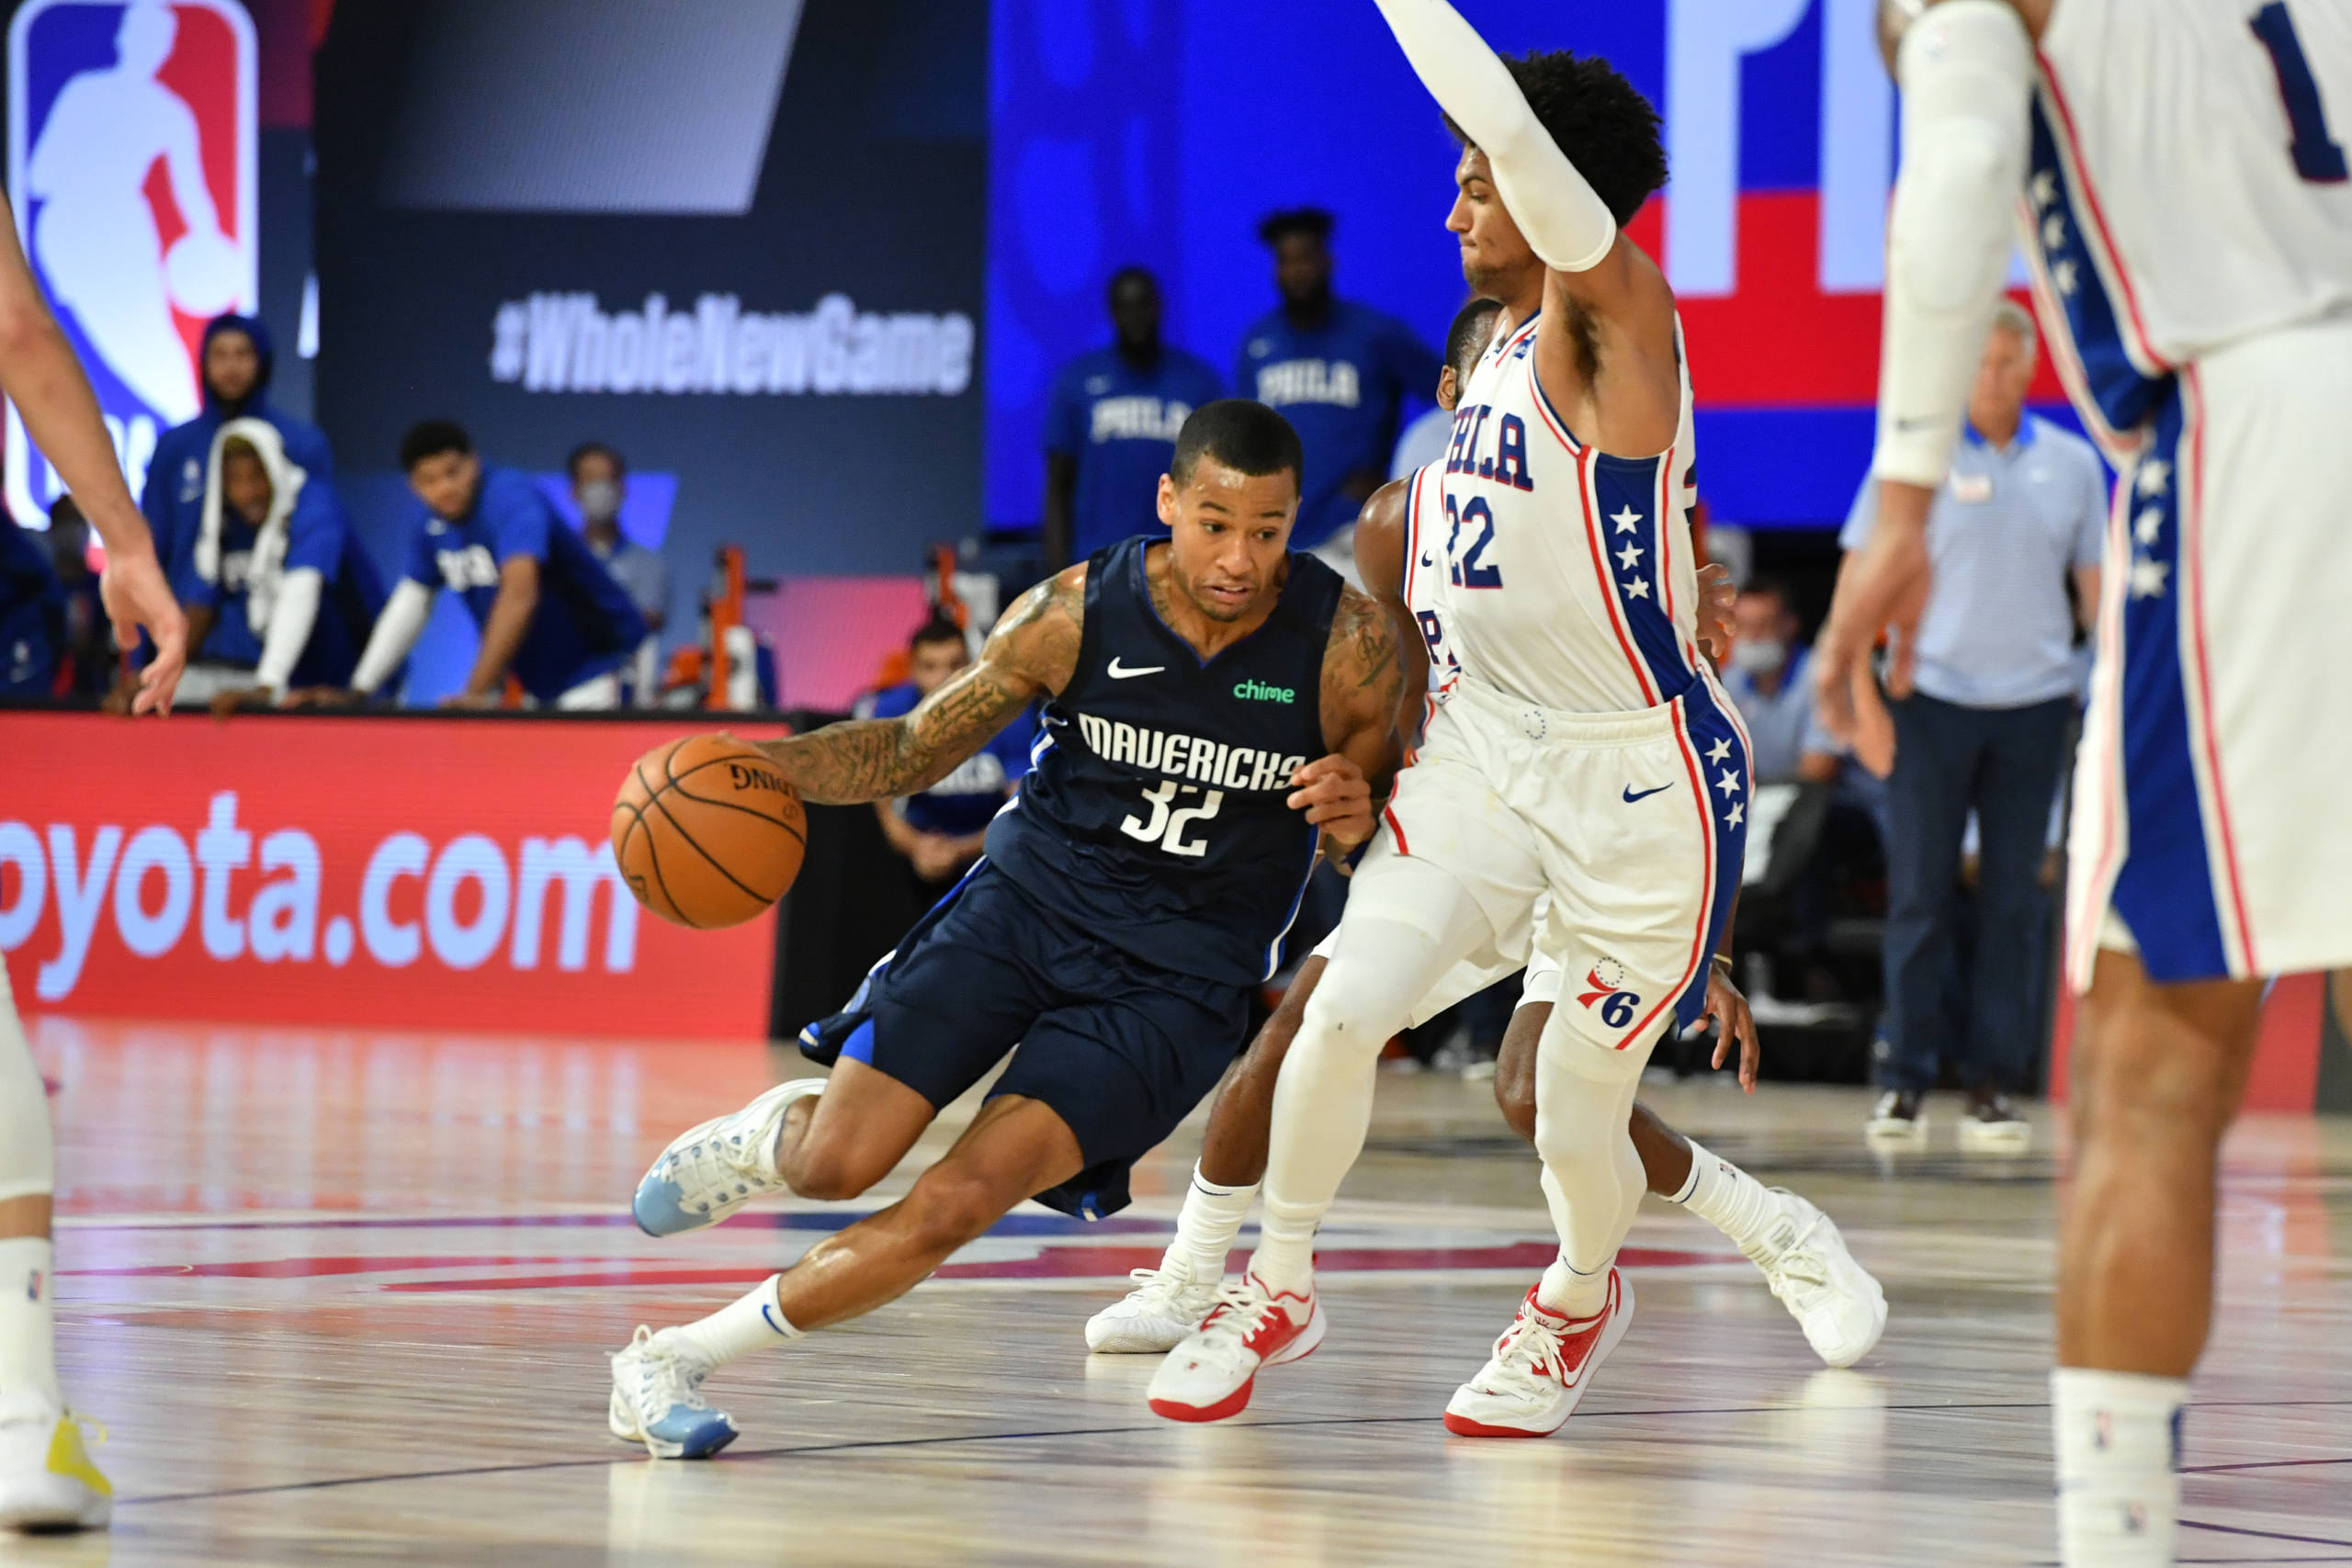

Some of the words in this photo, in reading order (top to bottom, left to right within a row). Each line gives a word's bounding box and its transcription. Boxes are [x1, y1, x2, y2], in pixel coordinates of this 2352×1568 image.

[492, 291, 974, 395] #WholeNewGame
[1255, 358, 1360, 409] PHILA
[1233, 679, 1295, 705] chime
[1078, 712, 1306, 791] MAVERICKS
[1119, 780, 1225, 857] 32
[0, 790, 640, 1002] oyota.com
